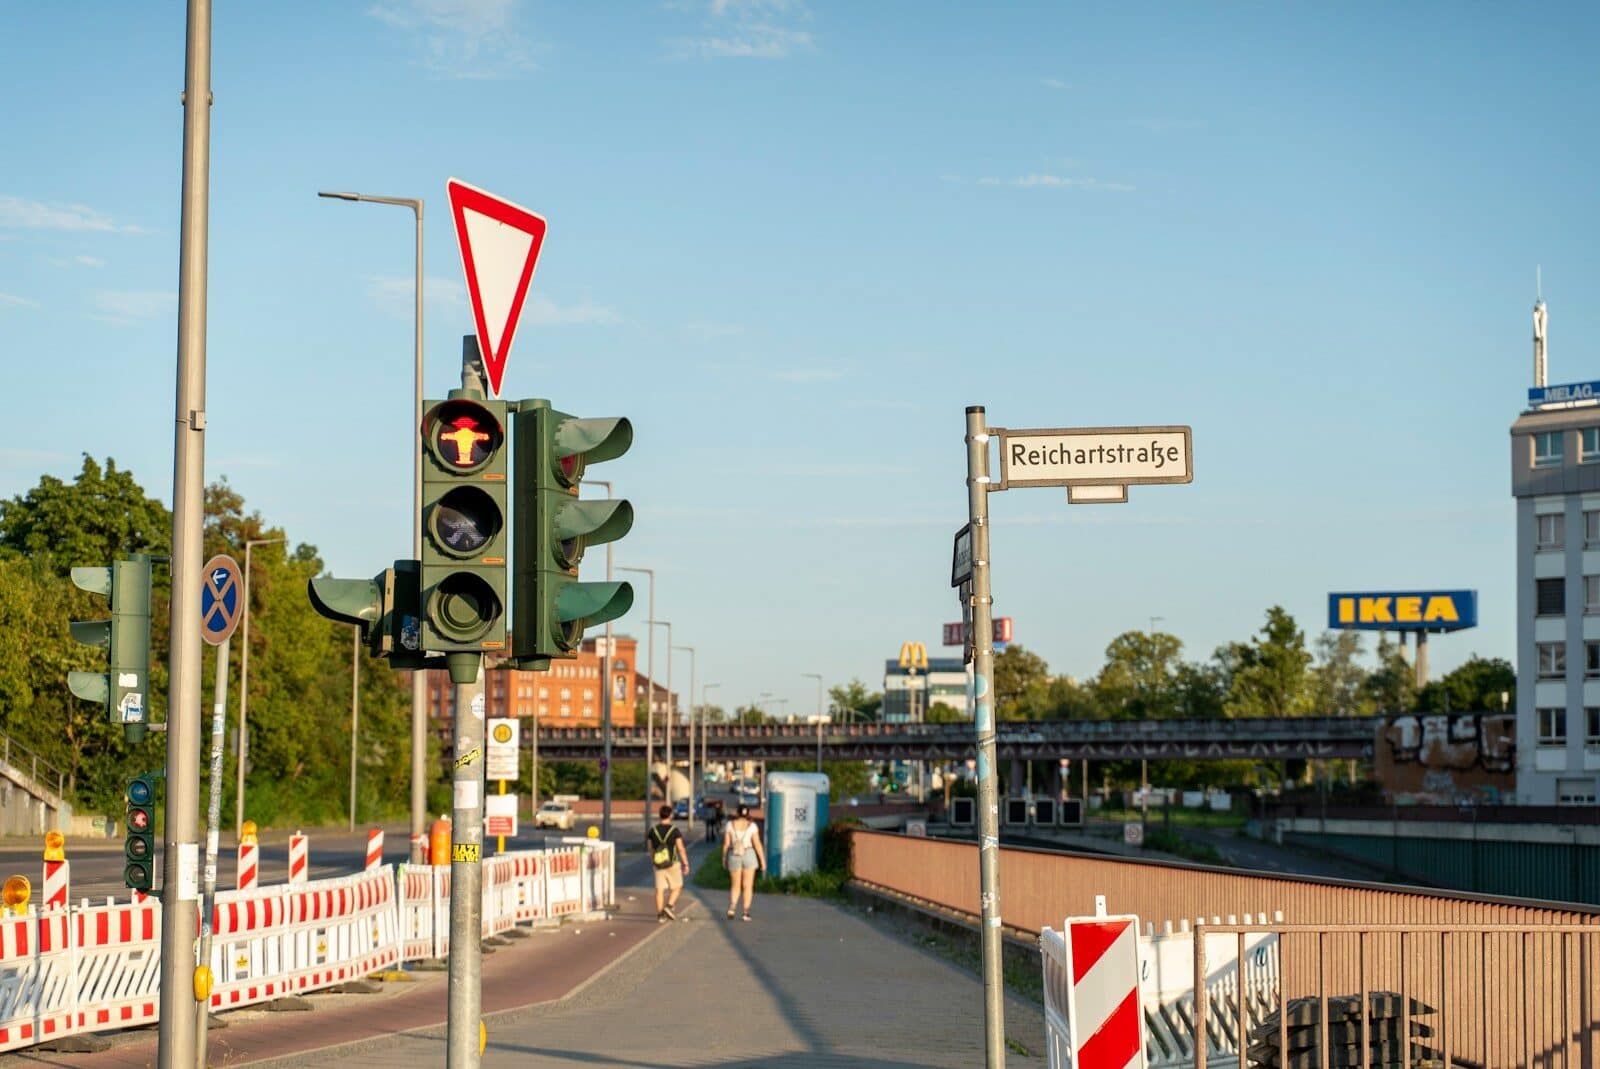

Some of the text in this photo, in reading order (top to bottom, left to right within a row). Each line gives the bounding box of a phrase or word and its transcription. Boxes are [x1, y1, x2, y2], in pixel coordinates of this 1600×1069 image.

[1544, 383, 1593, 401] MELAG
[1012, 441, 1179, 469] Reichartstraße
[1338, 596, 1460, 623] IKEA
